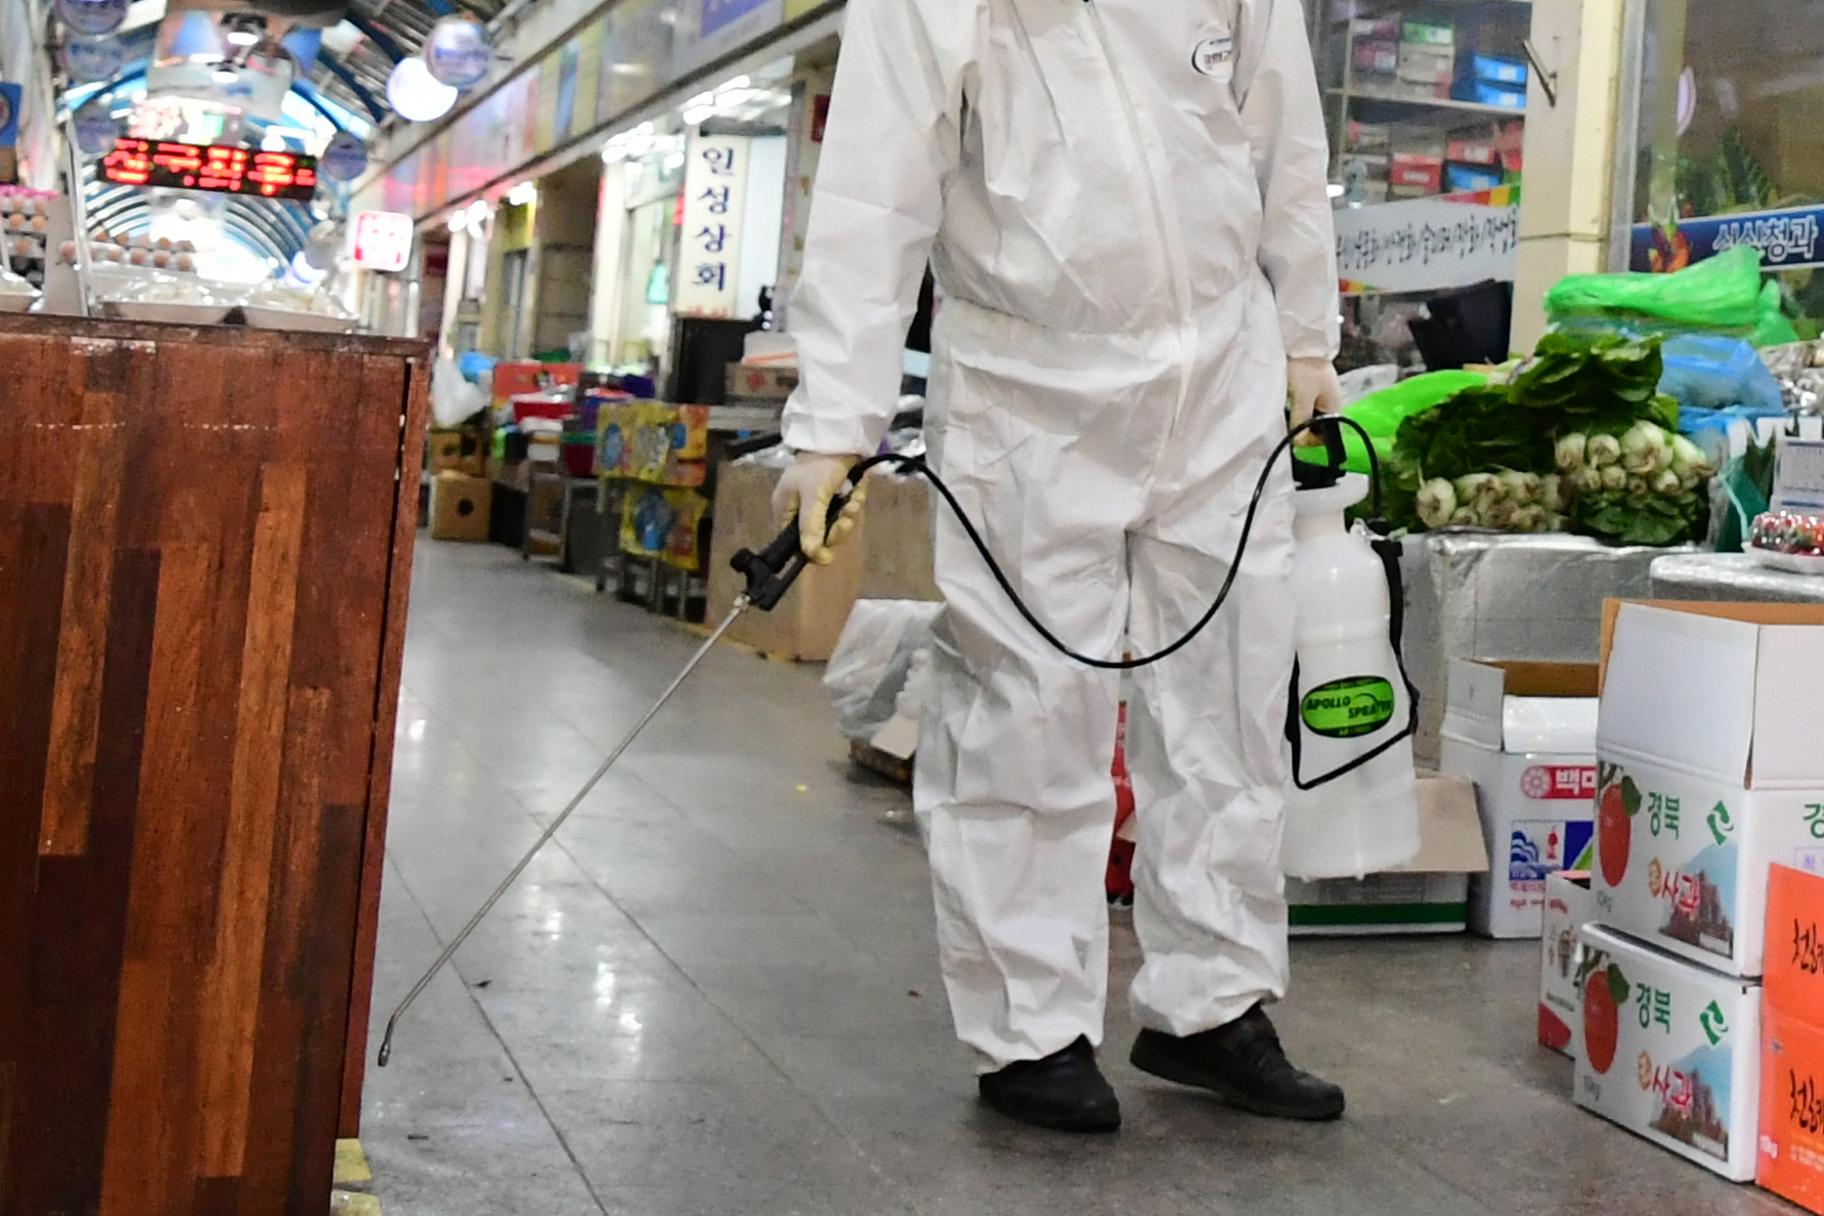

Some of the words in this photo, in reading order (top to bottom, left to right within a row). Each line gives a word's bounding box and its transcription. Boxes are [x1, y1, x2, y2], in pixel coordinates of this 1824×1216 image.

[1305, 695, 1352, 711] APOLLO
[1647, 790, 1680, 840] 경북
[1636, 982, 1671, 1035] 경북
